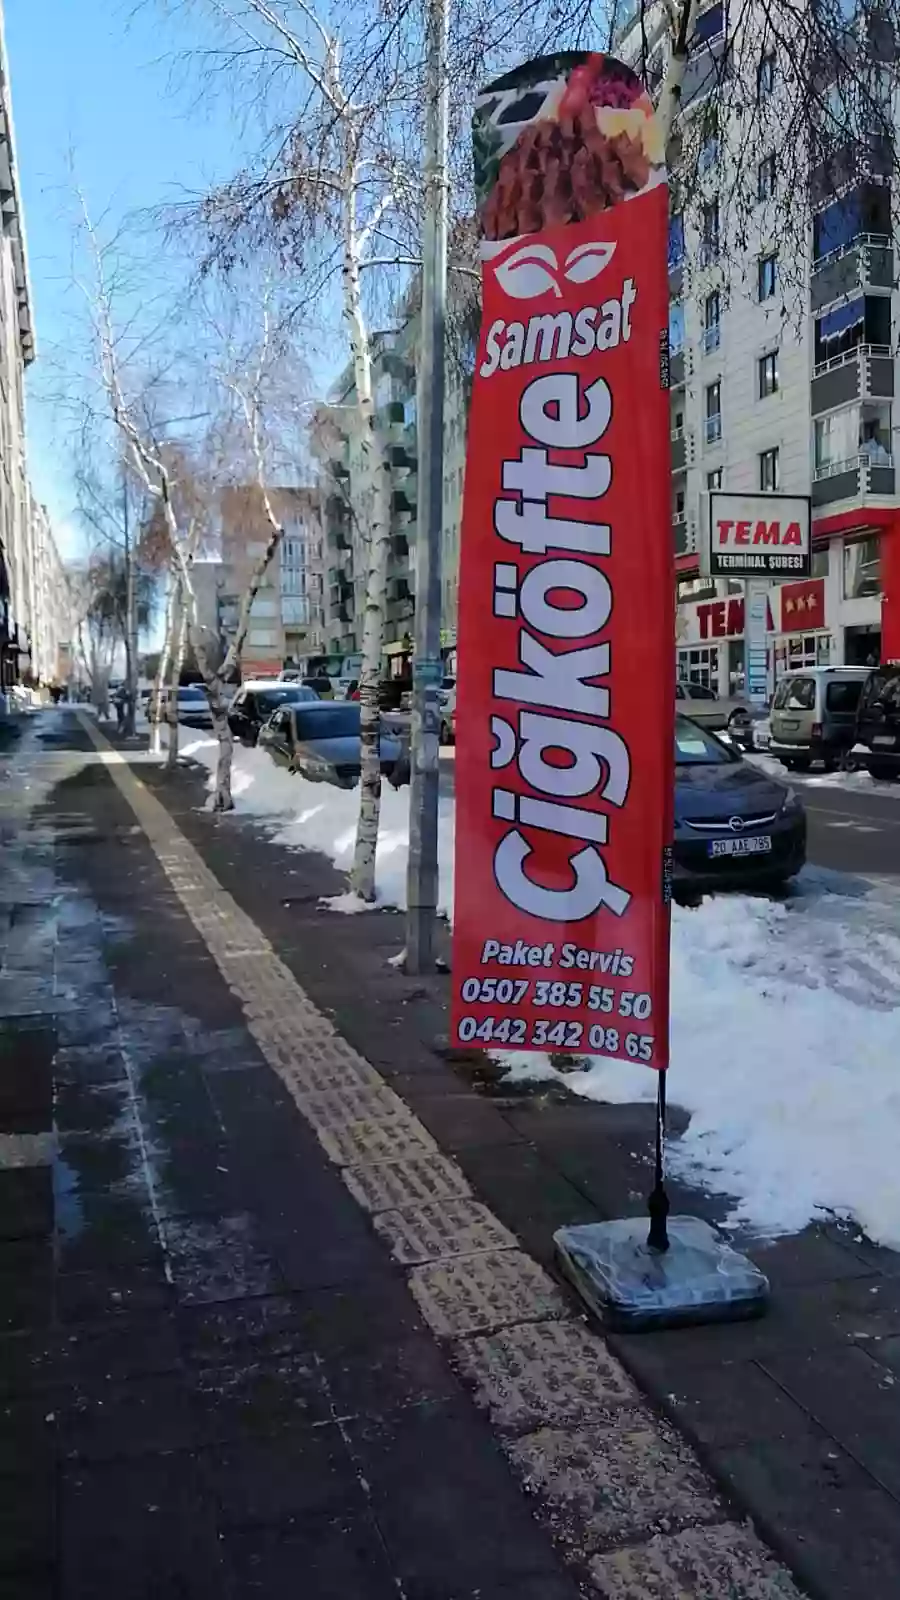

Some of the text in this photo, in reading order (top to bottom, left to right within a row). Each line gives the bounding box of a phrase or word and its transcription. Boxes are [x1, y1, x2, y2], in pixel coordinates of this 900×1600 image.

[716, 520, 802, 546] TEMA
[491, 372, 632, 923] Çiğköfte
[714, 842, 726, 854] 20
[481, 939, 634, 978] Paket Servis
[461, 977, 653, 1021] 0507 385 55 50
[457, 1016, 655, 1062] 0442 342 08 65
